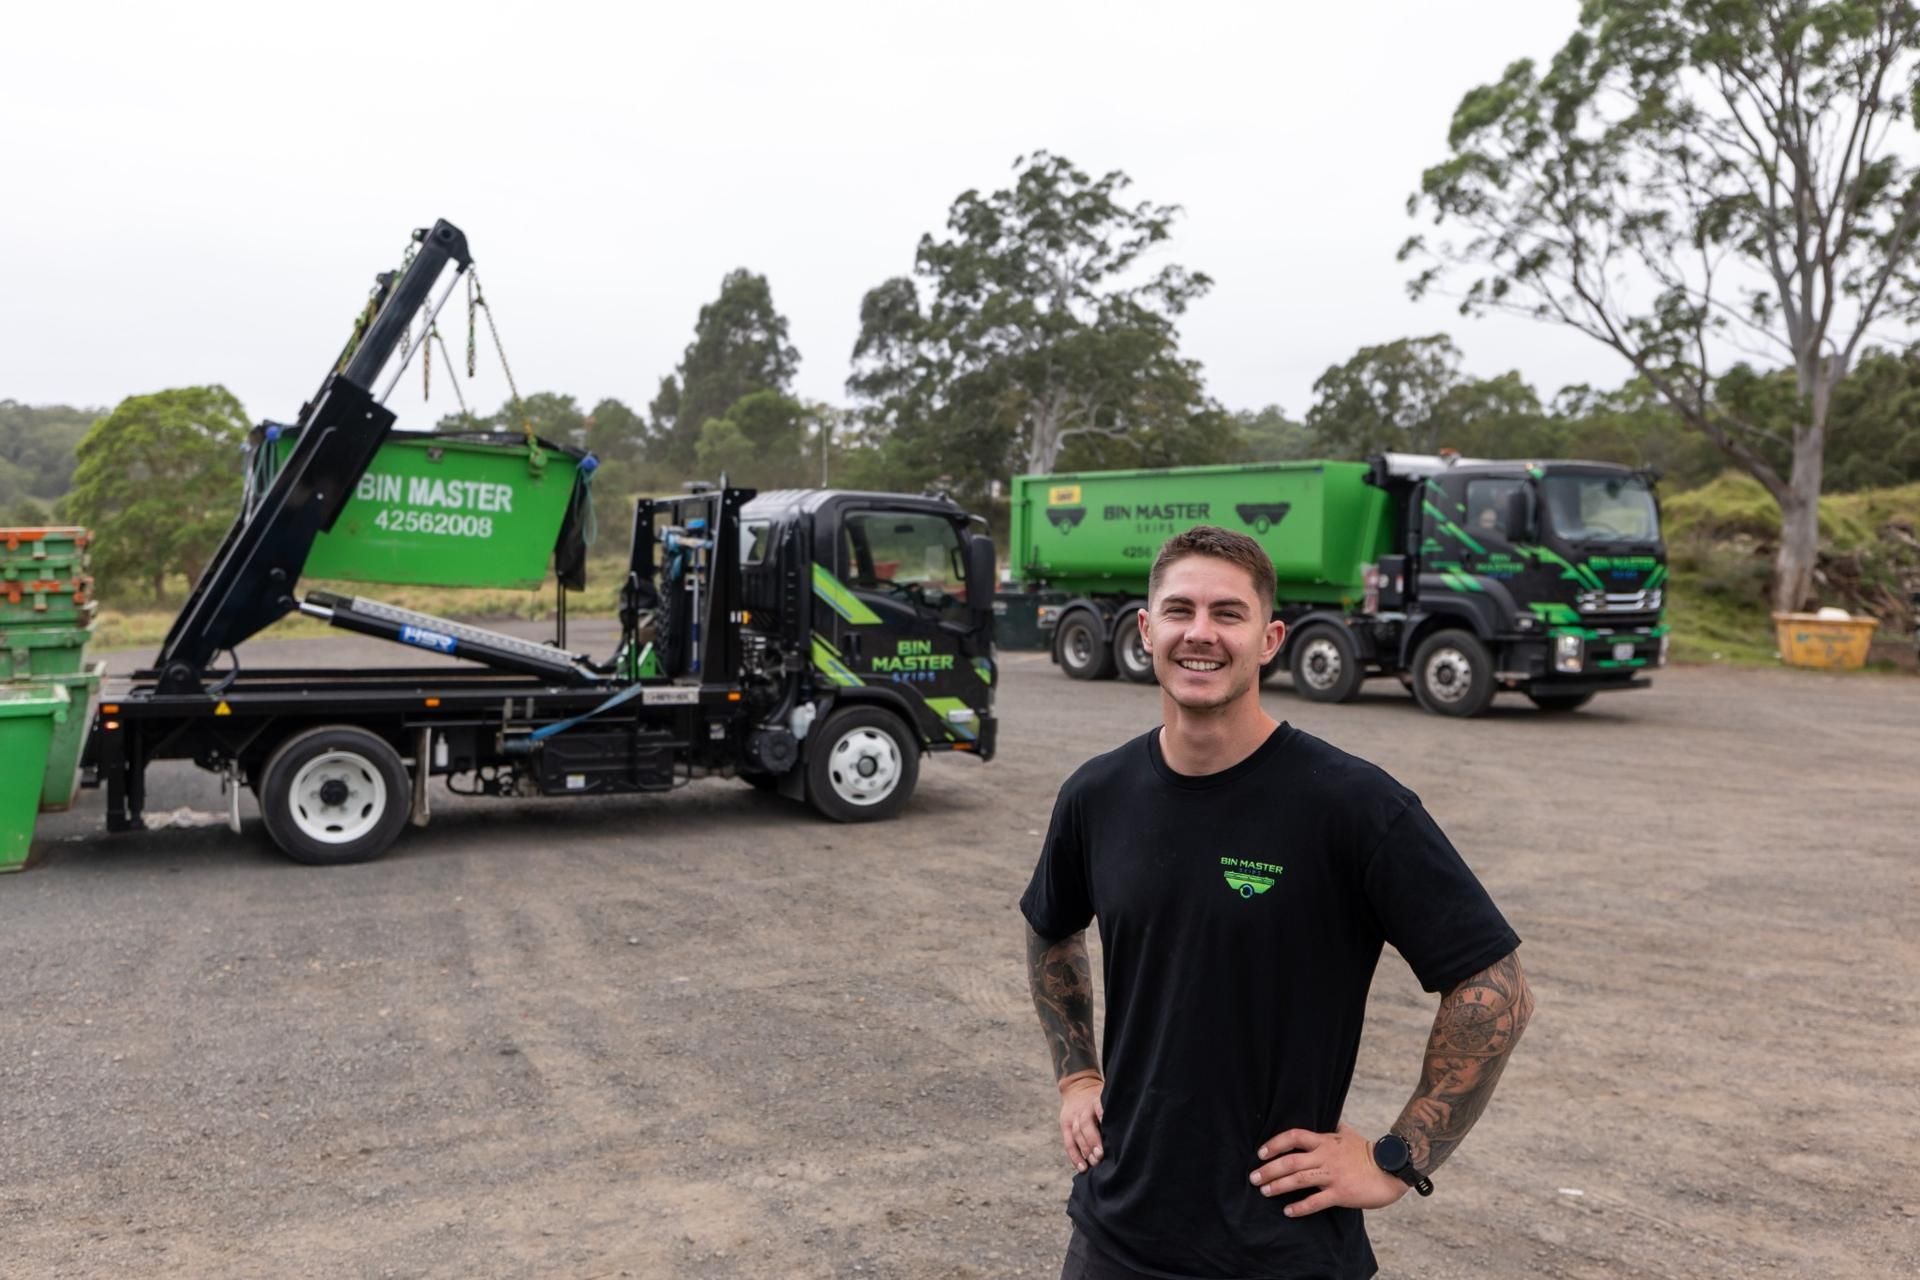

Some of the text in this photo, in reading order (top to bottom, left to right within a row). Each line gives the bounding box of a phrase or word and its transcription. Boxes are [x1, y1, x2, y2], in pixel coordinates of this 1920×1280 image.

[357, 473, 513, 512] BIN MASTER
[1103, 503, 1211, 520] BIN MASTER
[374, 509, 493, 538] 42562008
[1137, 523, 1174, 533] SKIPS
[897, 640, 932, 656] BIN
[872, 655, 954, 671] MASTER
[1221, 857, 1283, 874] BIN MASTER
